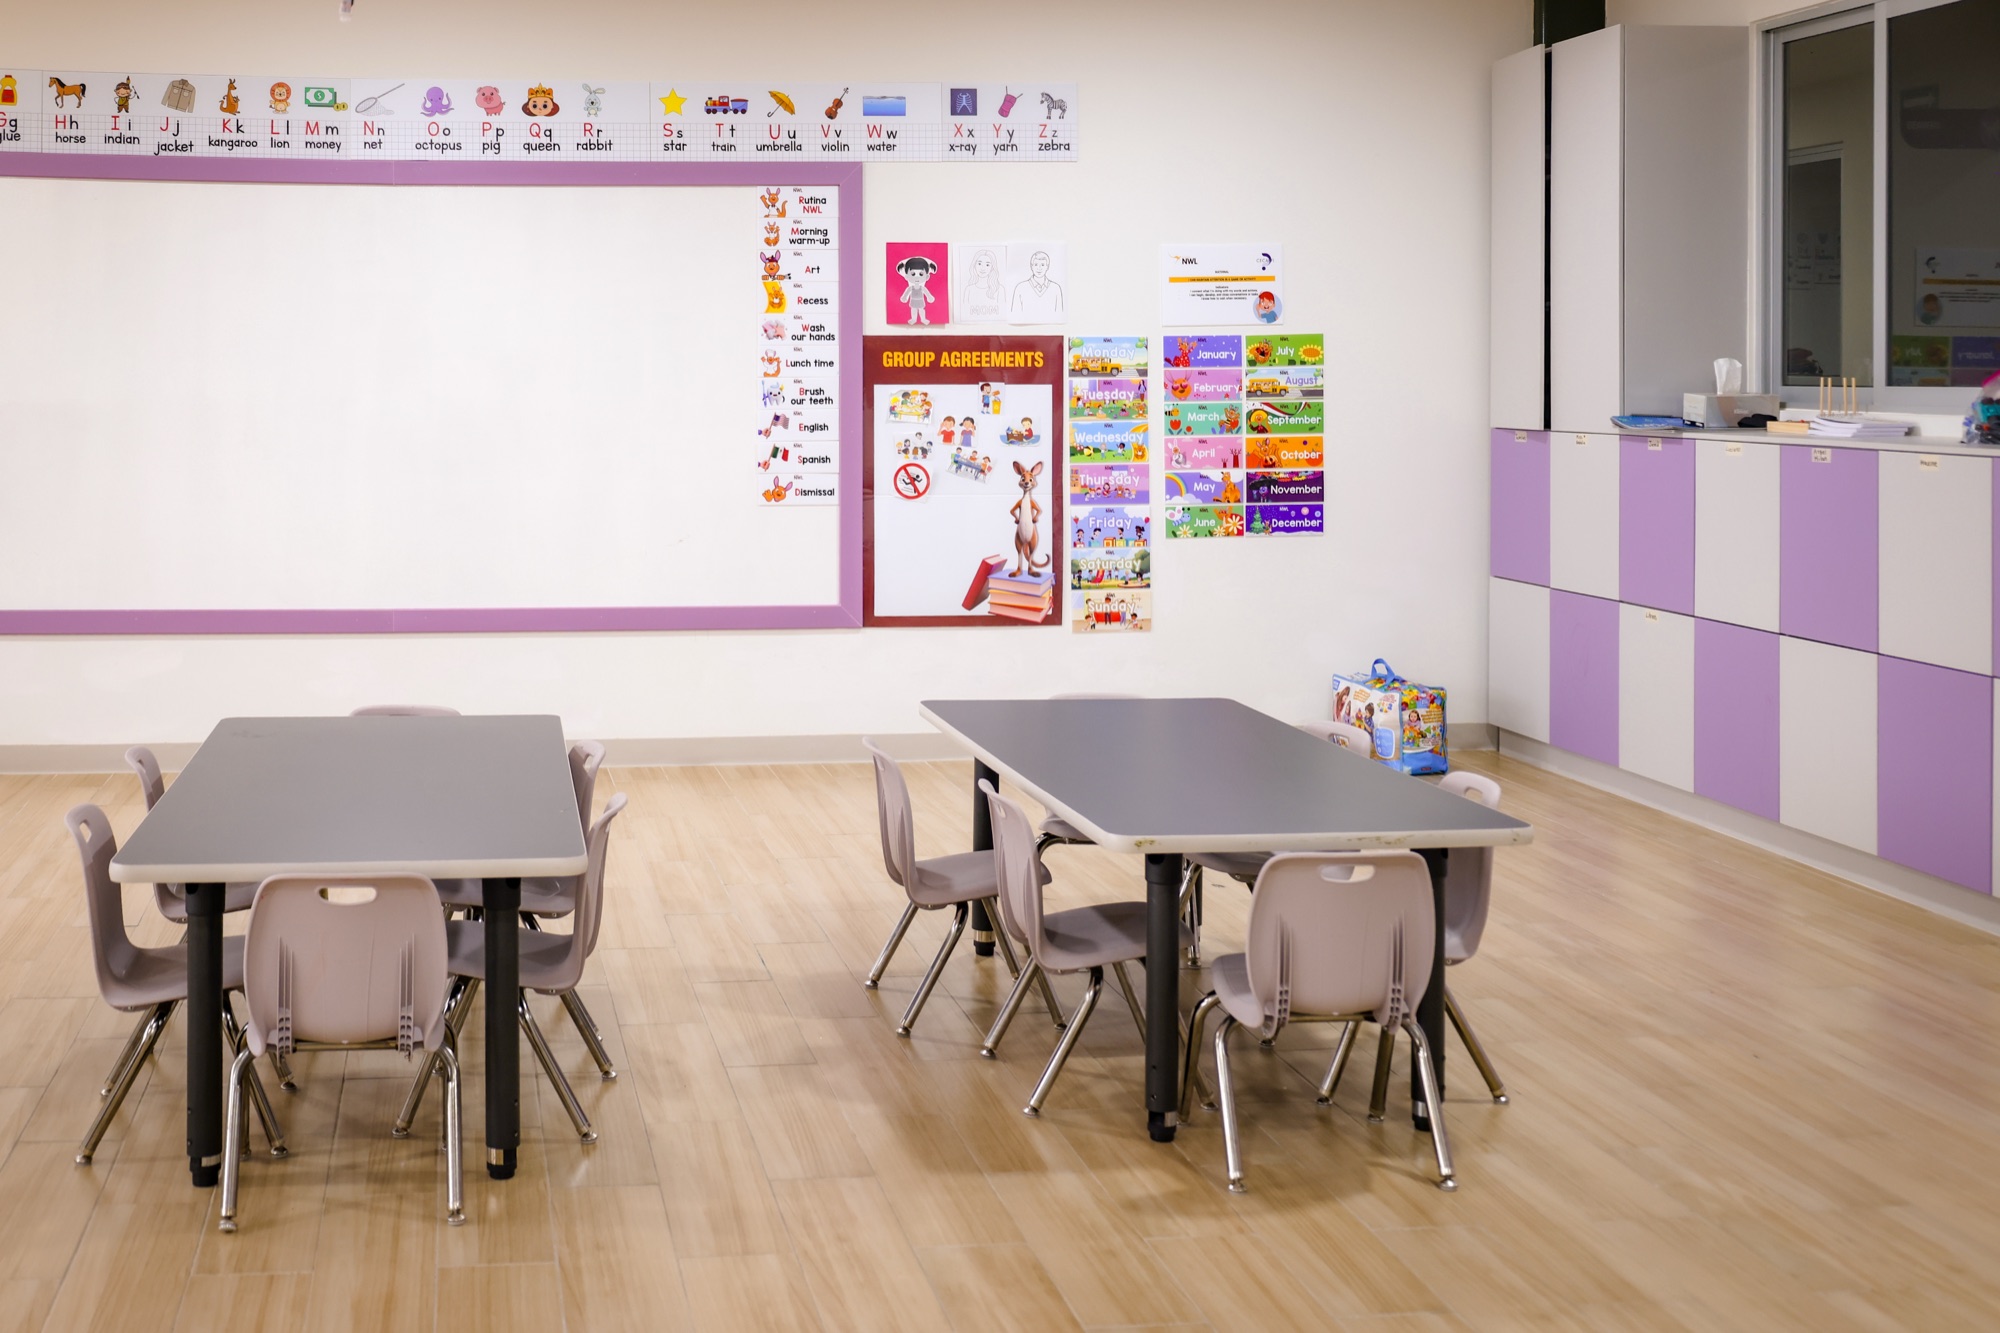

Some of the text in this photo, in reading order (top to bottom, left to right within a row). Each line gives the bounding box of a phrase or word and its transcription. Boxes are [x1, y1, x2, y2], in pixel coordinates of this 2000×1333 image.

[0, 129, 21, 144] lue
[56, 132, 86, 144] horse
[104, 133, 140, 145] indian
[154, 139, 194, 156] jacket
[208, 136, 258, 151] kangaroo
[270, 138, 290, 149] lion
[305, 141, 342, 153] money
[364, 139, 383, 150] net
[415, 141, 462, 154] octopus
[482, 141, 501, 155] pig
[523, 141, 561, 154] queen
[576, 139, 613, 151] rabbit
[663, 140, 687, 151] star
[711, 141, 736, 152] train
[756, 141, 802, 152] umbrella
[821, 141, 850, 152] violin
[867, 142, 897, 153] water
[949, 142, 977, 155] x-ray
[993, 142, 1018, 155] yarn
[1038, 141, 1070, 152] zebra
[799, 196, 826, 204] Rutina
[803, 206, 822, 214] NWL
[791, 227, 828, 237] Morning
[789, 237, 830, 246] warm-up
[805, 266, 820, 274] Art
[797, 297, 828, 305] Recess
[801, 324, 825, 332] Wash
[809, 332, 835, 341] hands
[1081, 347, 1135, 360] Monday
[1196, 350, 1236, 361] January
[1276, 346, 1295, 357] July
[786, 359, 834, 367] Lunch time
[882, 351, 1044, 368] GROUP AGREEMENTS
[1285, 376, 1319, 386] August
[1194, 383, 1239, 394] February
[1082, 388, 1135, 402] Tuesday
[809, 397, 833, 405] teeth
[1187, 412, 1219, 422] March
[1268, 415, 1321, 426] September
[799, 423, 829, 433] English
[1074, 432, 1144, 444] Wednesday
[1192, 449, 1215, 459] April
[1280, 450, 1321, 460] October
[798, 456, 831, 465] Spanish
[1080, 474, 1140, 486] Thursday
[795, 488, 835, 496] Dismissal
[1194, 483, 1215, 493] May
[1270, 484, 1322, 494] November
[1089, 517, 1132, 530] Friday
[1194, 518, 1215, 527] June
[1272, 518, 1322, 528] December
[1079, 559, 1141, 572] Saturday
[1088, 601, 1135, 613] Sunday
